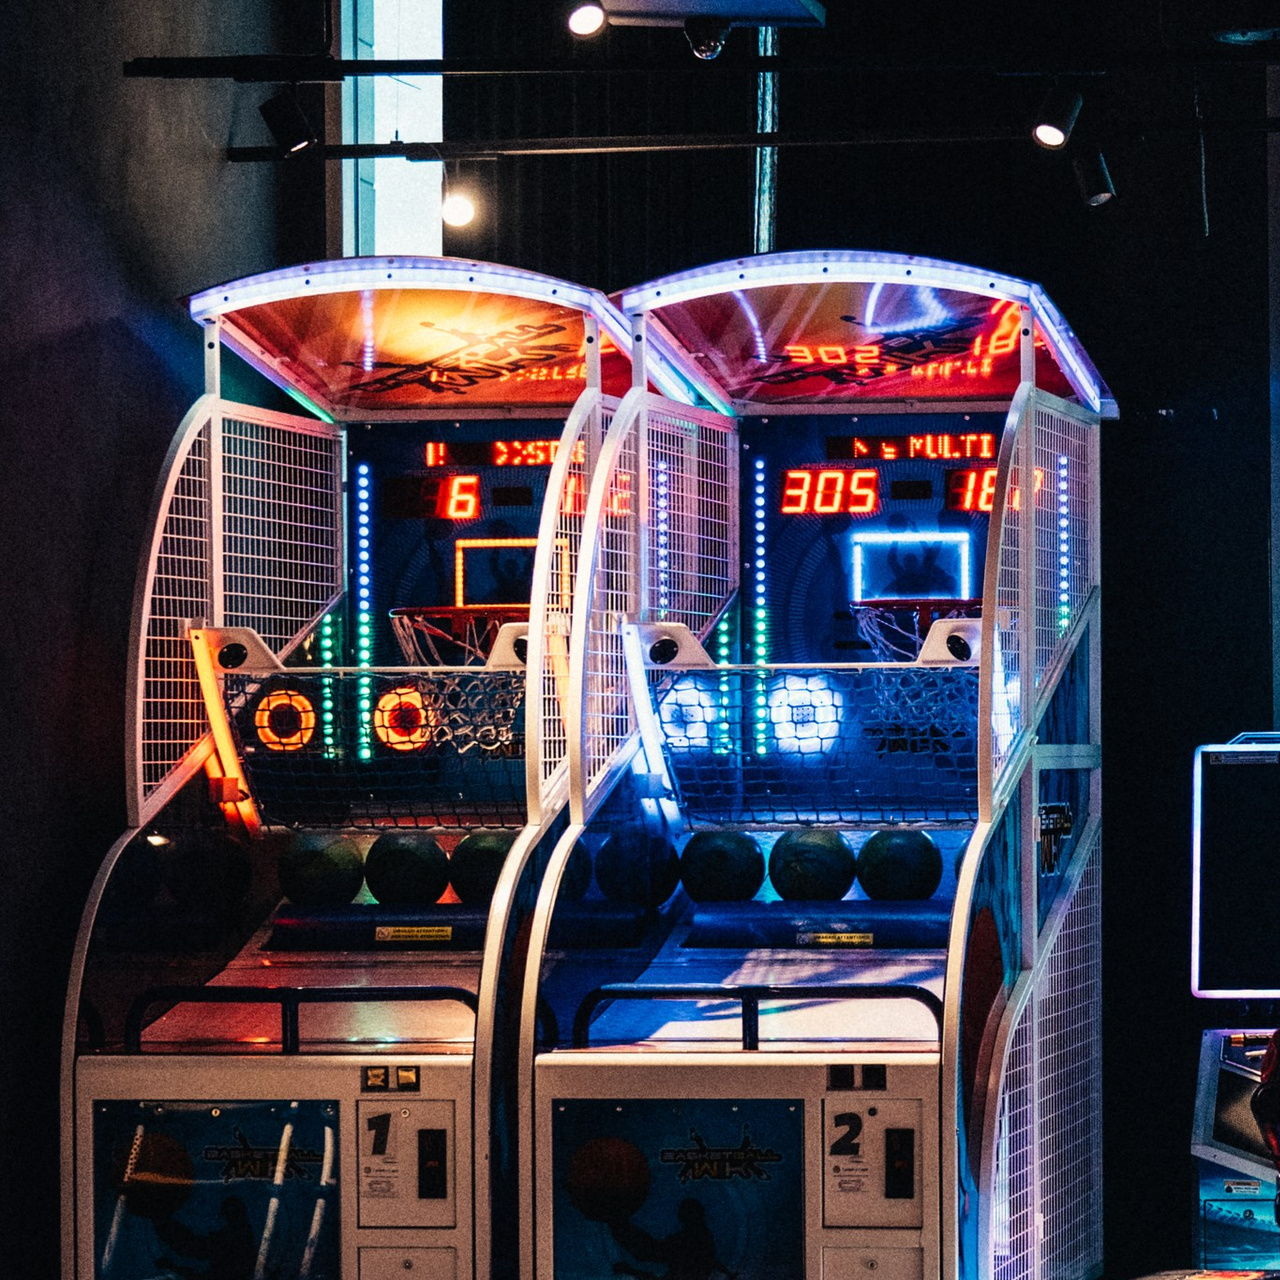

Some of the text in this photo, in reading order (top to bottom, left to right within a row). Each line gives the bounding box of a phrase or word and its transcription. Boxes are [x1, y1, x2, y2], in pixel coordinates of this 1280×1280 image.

[781, 470, 878, 514] 305
[366, 1113, 392, 1155] 1
[829, 1112, 863, 1155] 2
